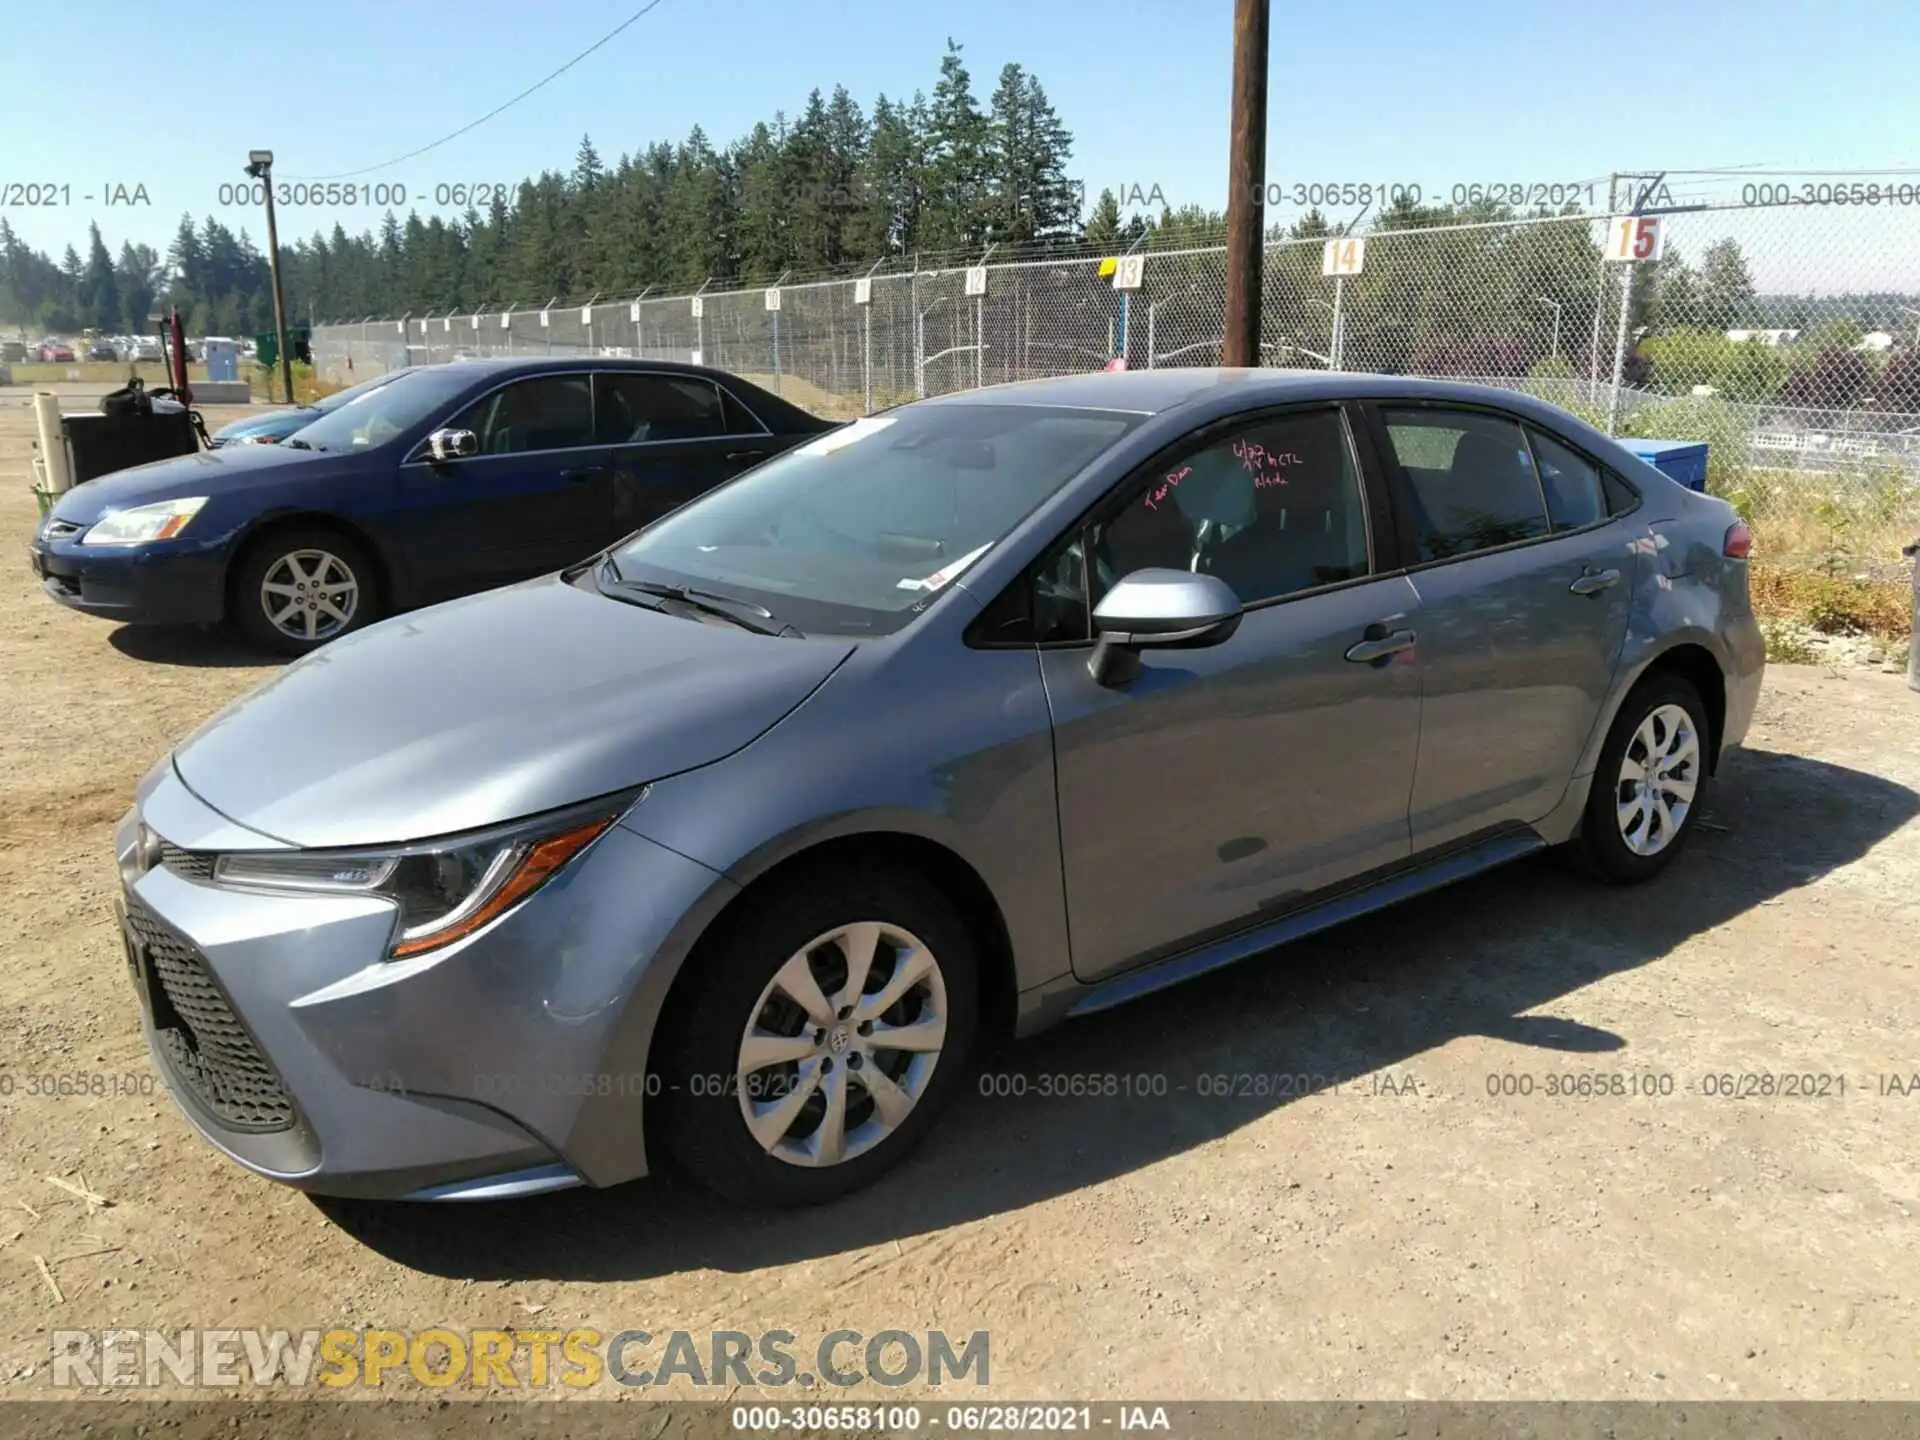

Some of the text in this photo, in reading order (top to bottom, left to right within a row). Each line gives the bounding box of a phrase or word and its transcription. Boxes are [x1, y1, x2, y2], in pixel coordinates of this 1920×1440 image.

[1620, 217, 1657, 258] 15
[1332, 239, 1356, 272] 14
[970, 270, 981, 292] 12
[1120, 260, 1137, 285] 13
